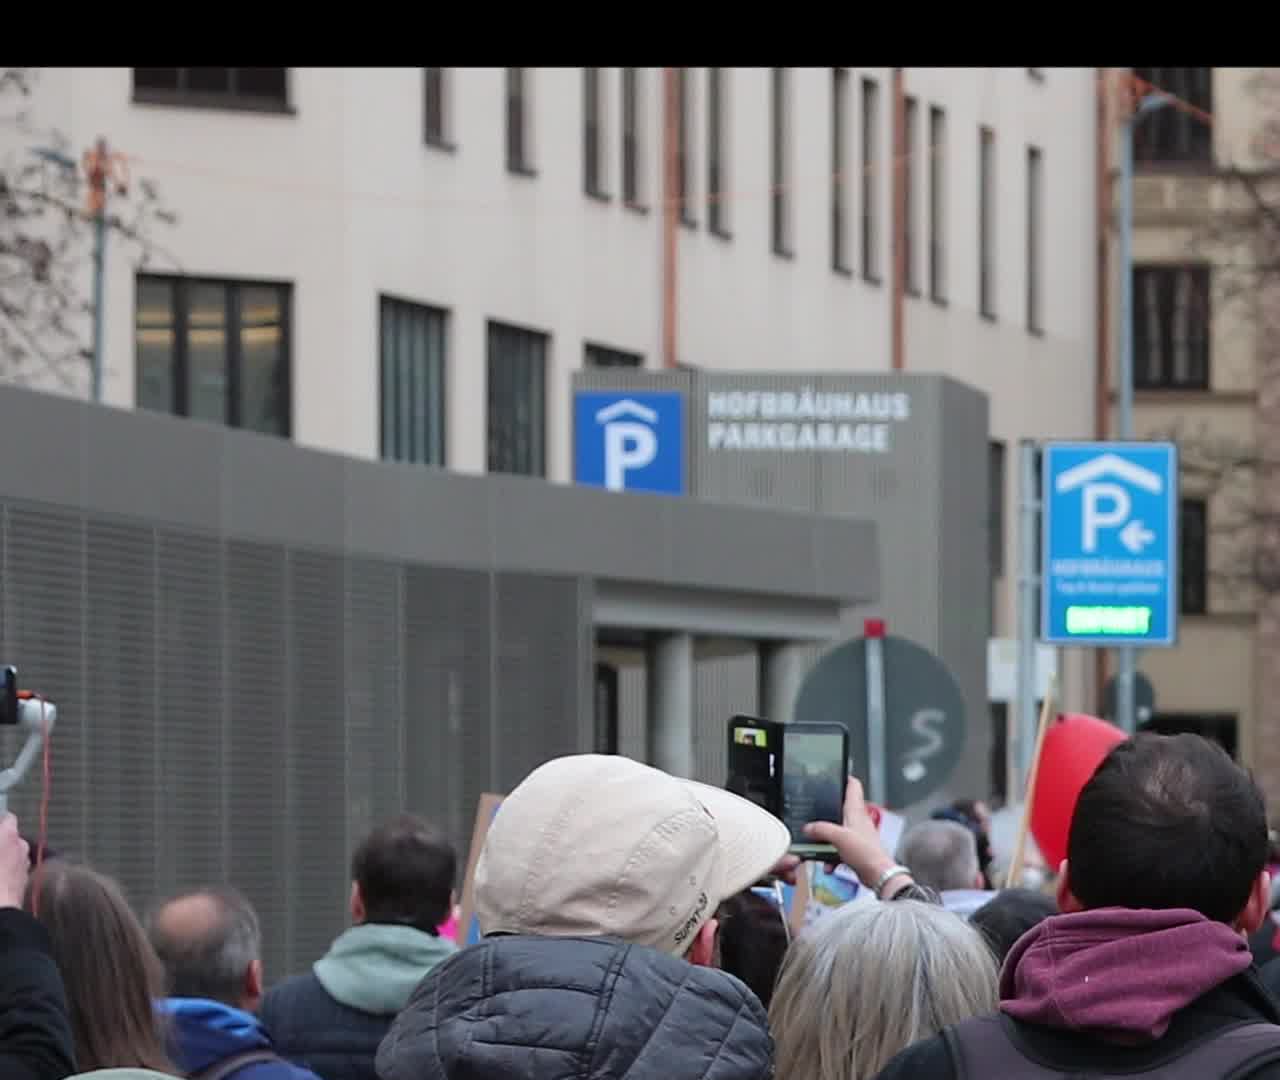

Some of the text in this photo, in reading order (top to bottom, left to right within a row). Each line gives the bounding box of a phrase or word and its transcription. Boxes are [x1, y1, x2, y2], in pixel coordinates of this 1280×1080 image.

[707, 386, 911, 421] HOFBRÄUHAUS
[707, 422, 889, 452] PARKGARAGE
[1080, 483, 1132, 553] P
